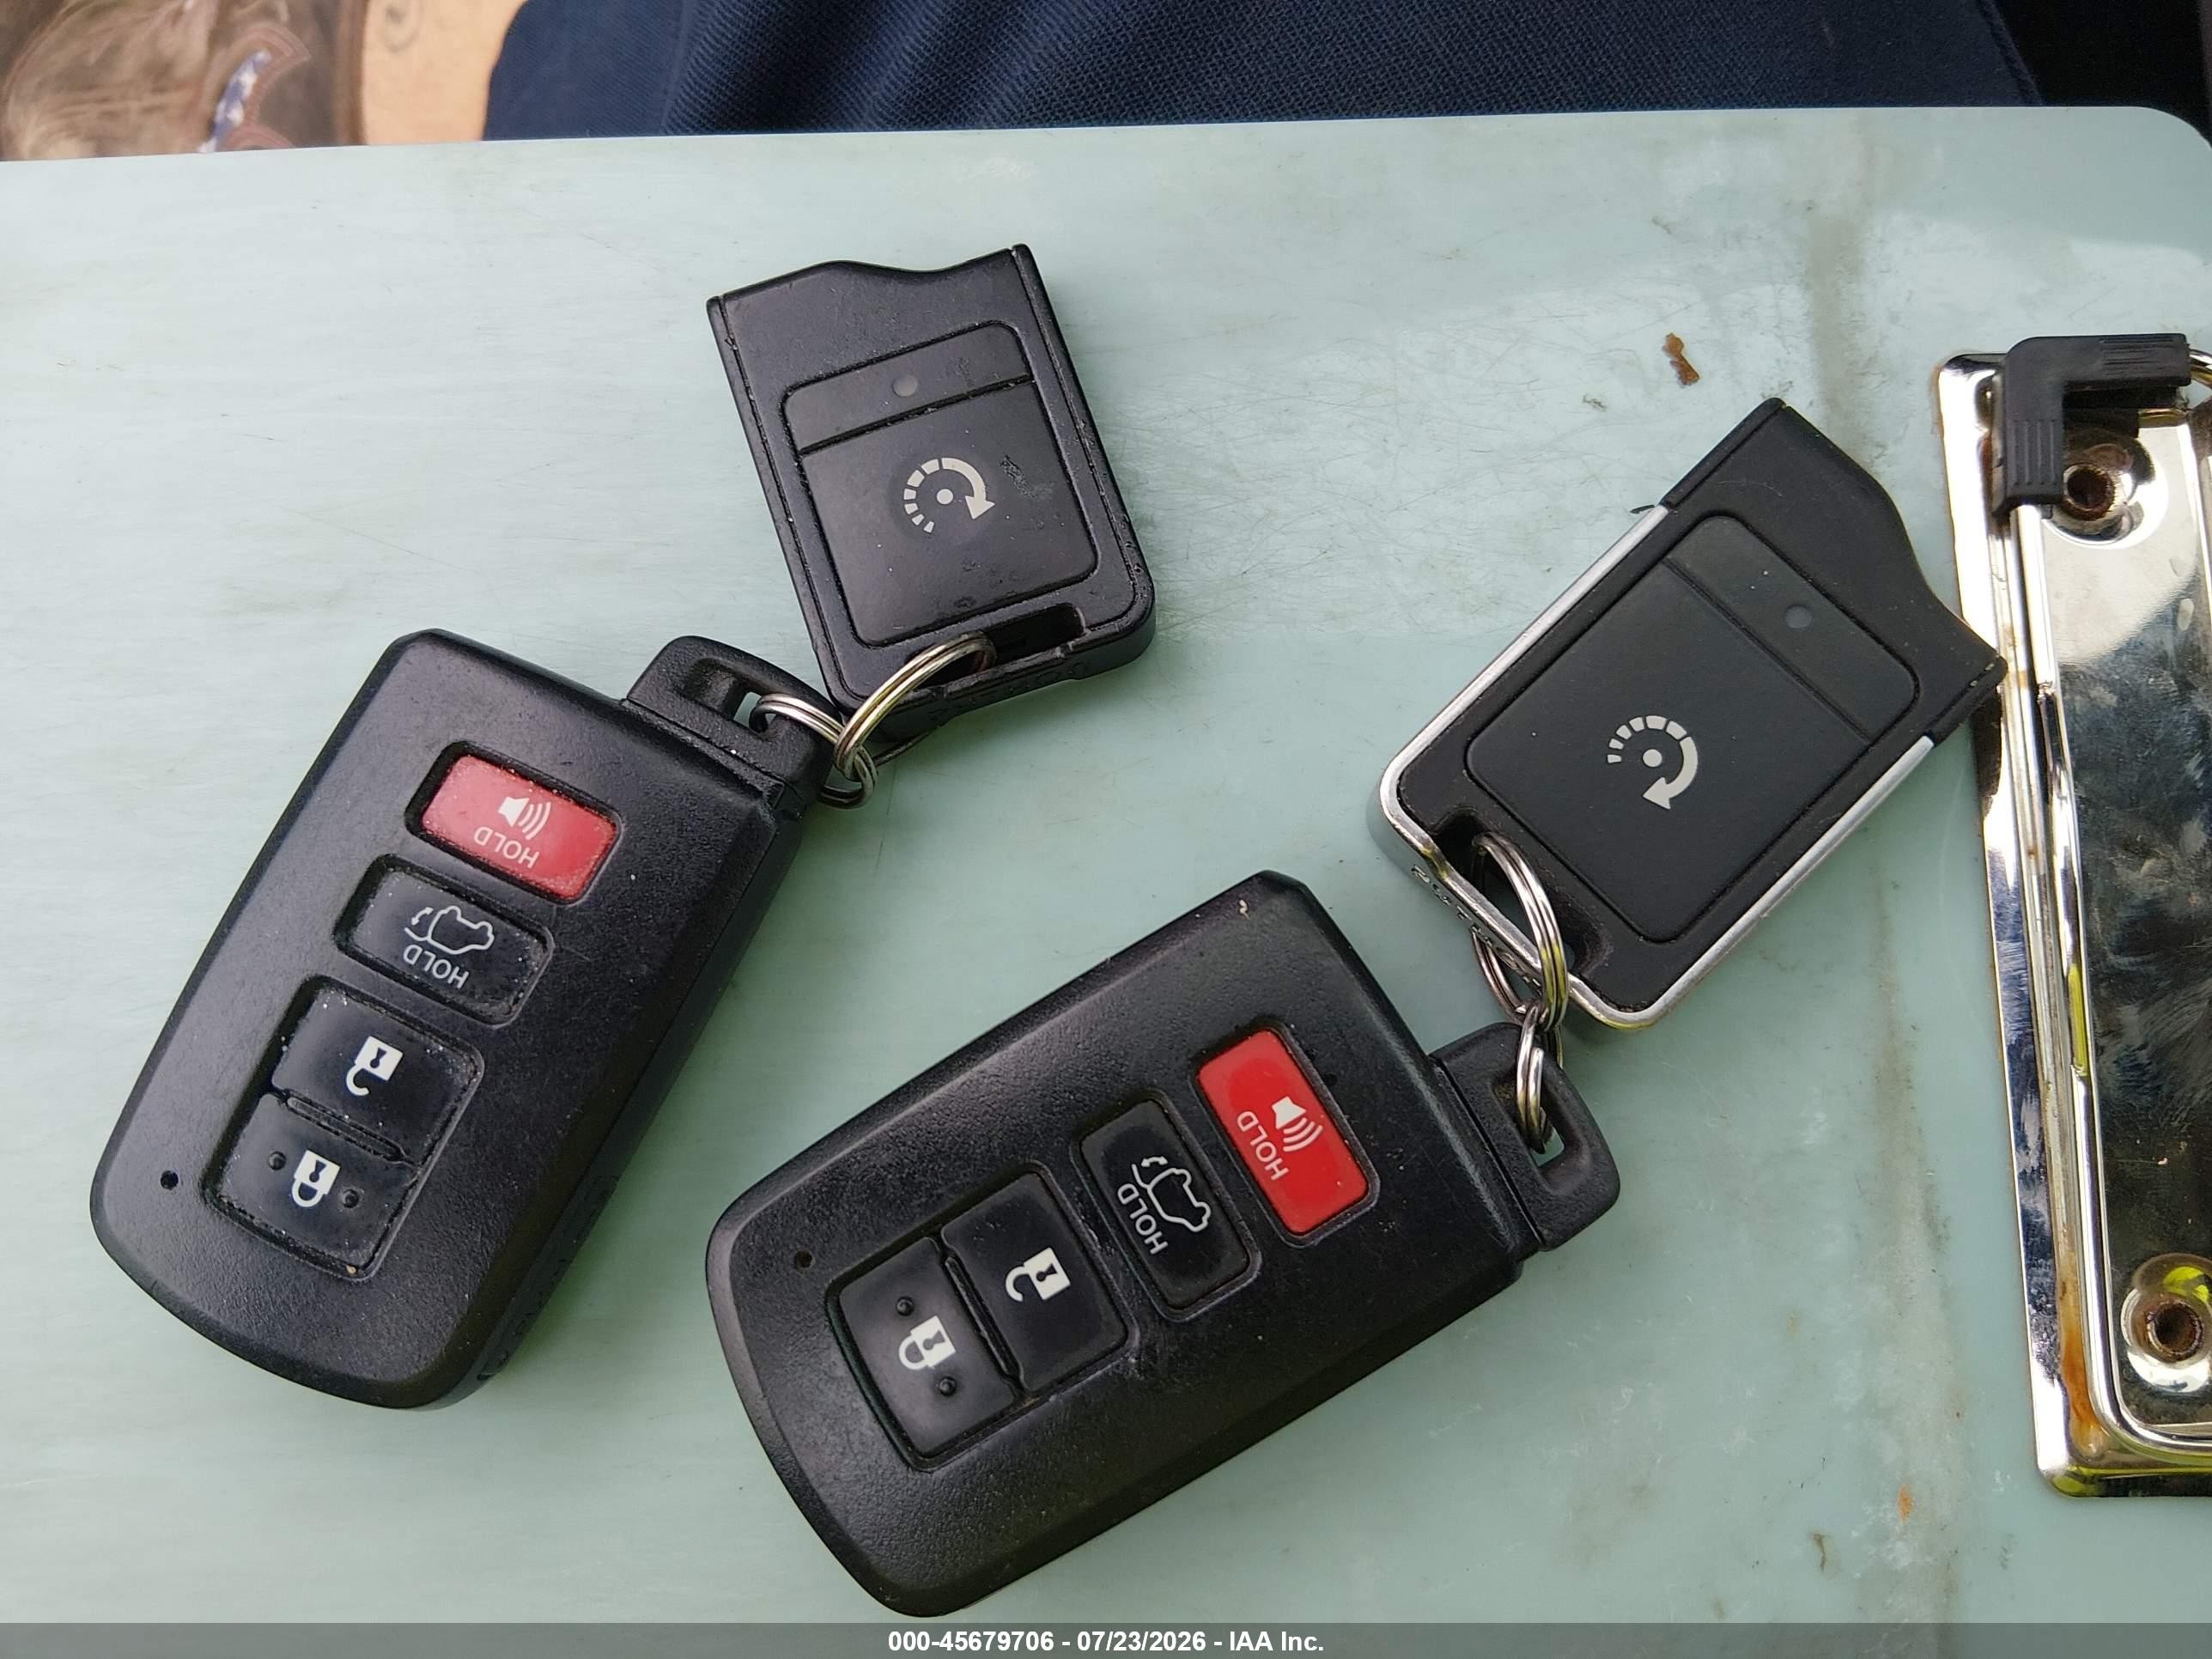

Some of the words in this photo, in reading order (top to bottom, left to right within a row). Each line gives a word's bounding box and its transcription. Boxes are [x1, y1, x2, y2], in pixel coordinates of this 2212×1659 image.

[473, 825, 540, 870] HOLD
[403, 944, 470, 989] HOLD
[1236, 1109, 1289, 1181] HOLD
[1117, 1182, 1169, 1255] HOLD
